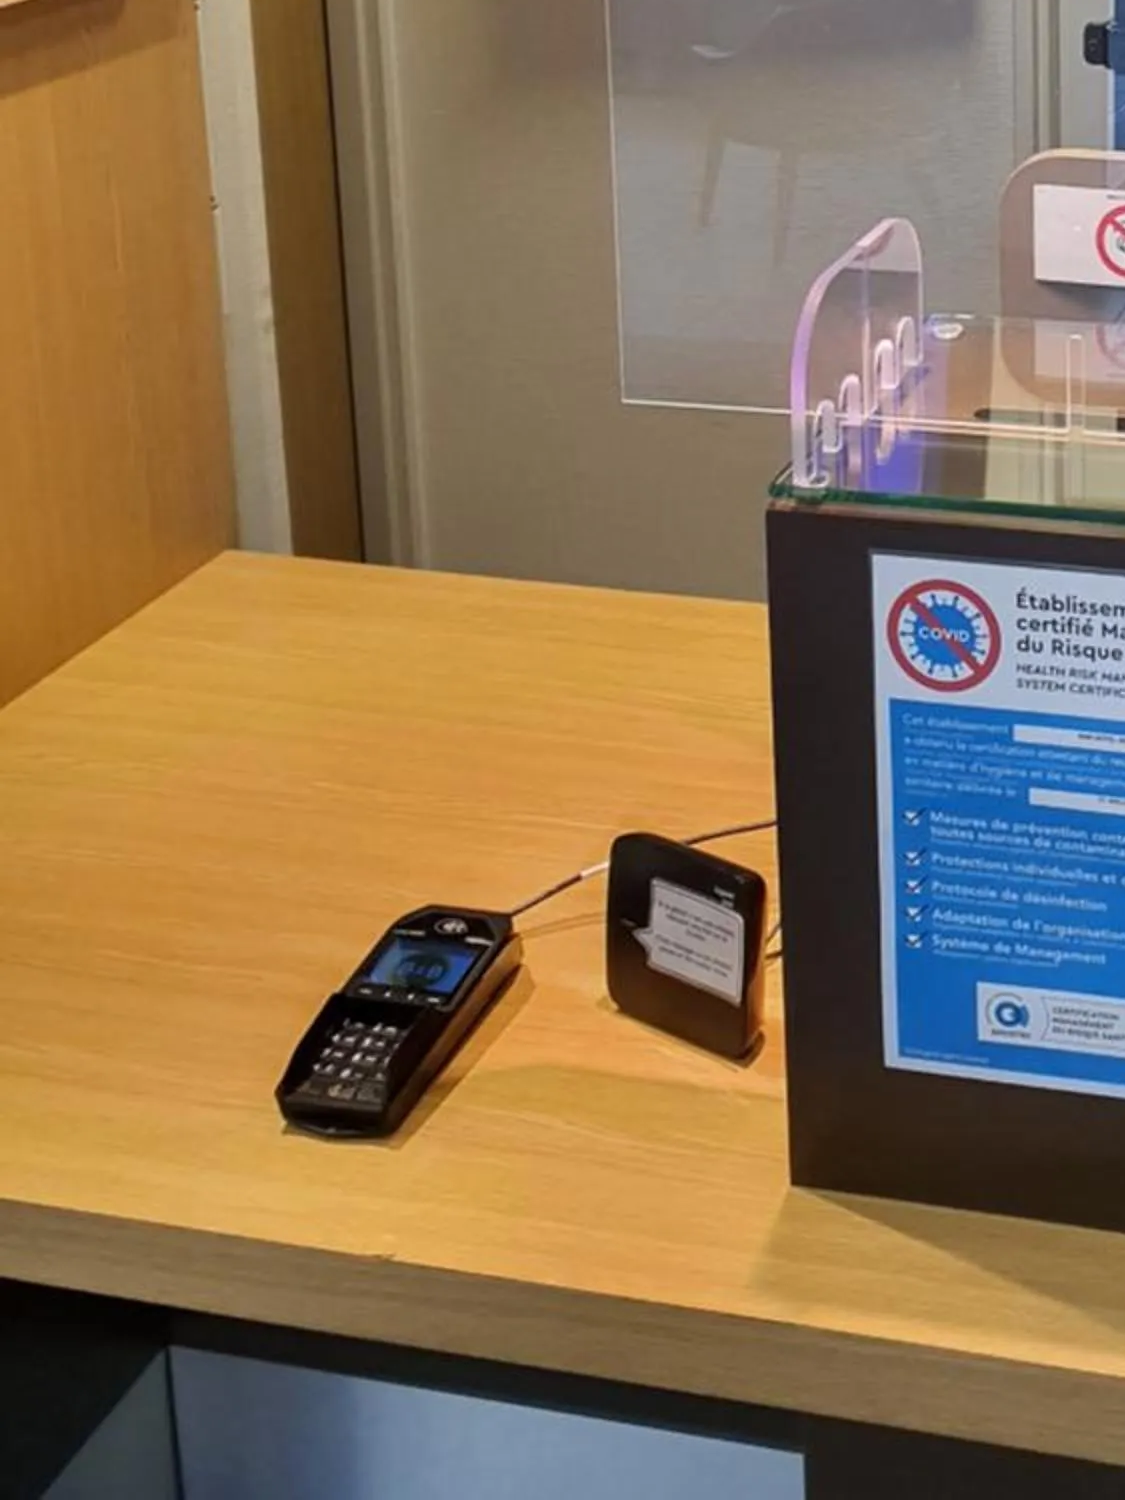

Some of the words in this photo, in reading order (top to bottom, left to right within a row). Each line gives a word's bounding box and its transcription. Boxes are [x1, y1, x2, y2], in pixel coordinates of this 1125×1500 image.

[1016, 616, 1094, 637] certifié
[1016, 635, 1044, 654] du
[1051, 639, 1124, 662] Risque
[1016, 663, 1066, 677] HEALTH
[1069, 667, 1098, 679] RISK
[1016, 677, 1066, 692] SYSTEM
[930, 811, 988, 829] Mesures
[990, 818, 1010, 831] de
[932, 908, 1010, 929] Adaptation
[1014, 943, 1107, 966] Management
